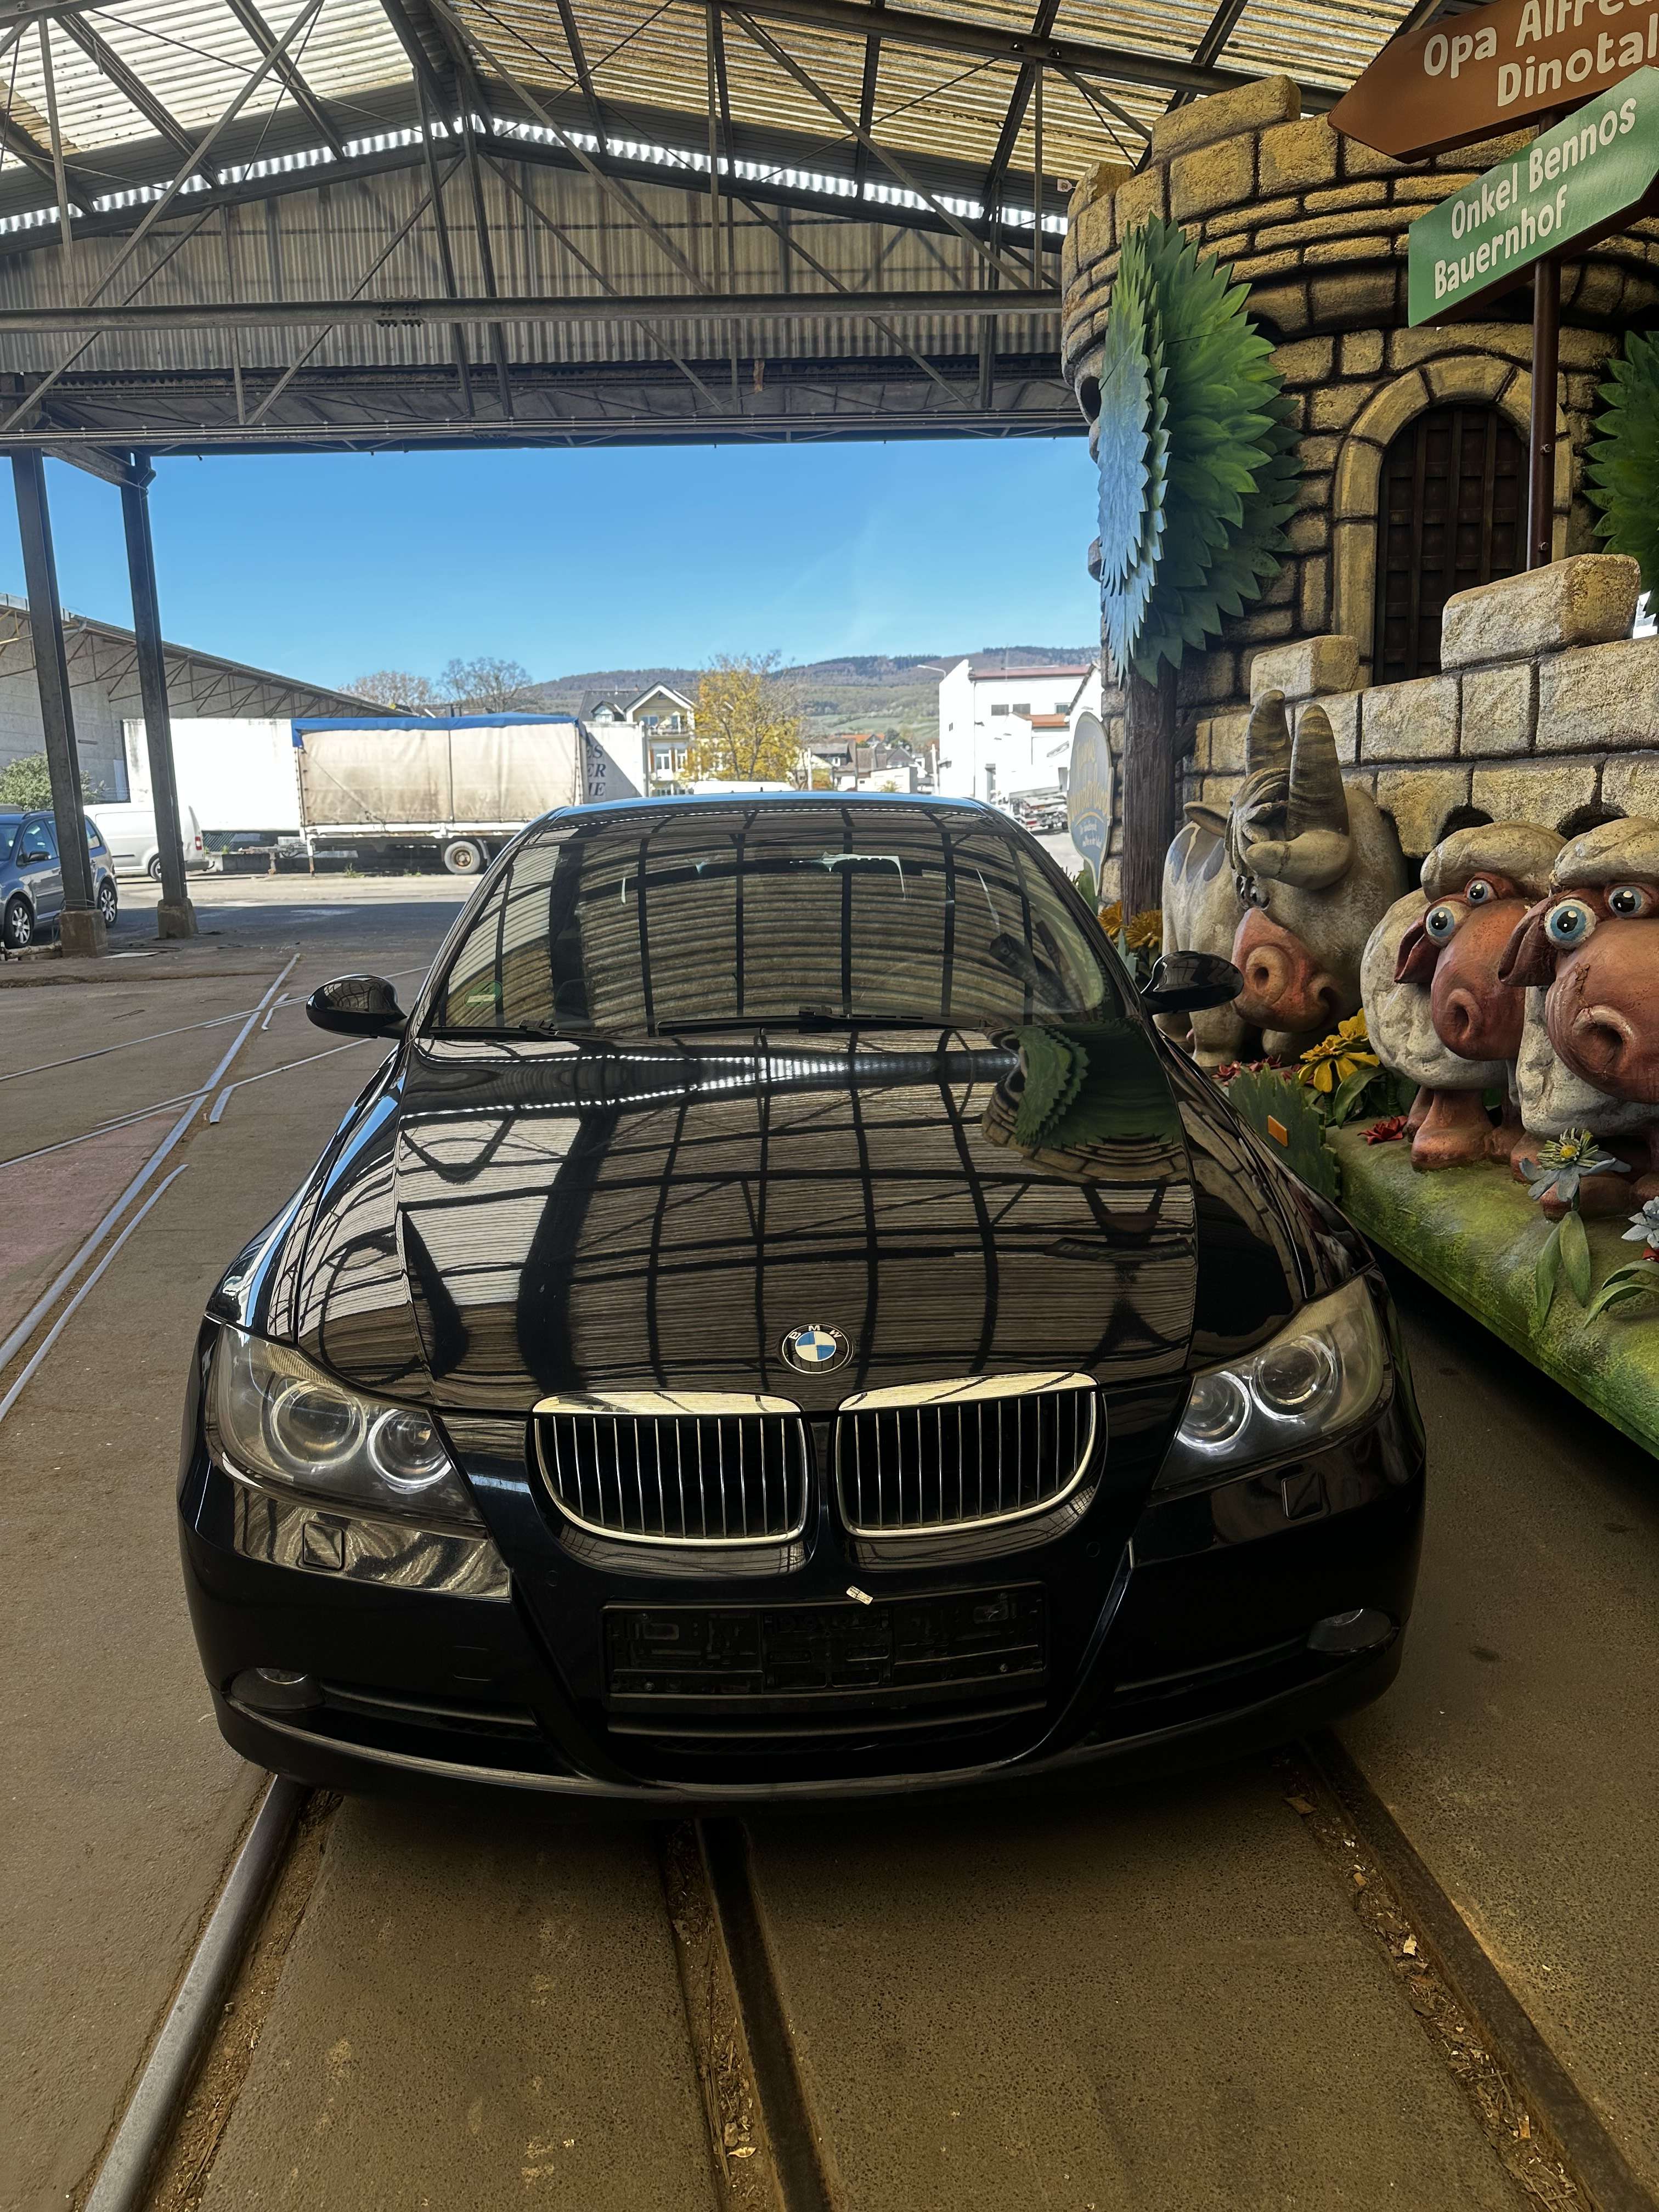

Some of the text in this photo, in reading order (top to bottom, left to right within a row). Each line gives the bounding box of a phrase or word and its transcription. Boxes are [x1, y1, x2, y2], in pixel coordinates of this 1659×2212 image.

[1424, 0, 1655, 78] Opa Alfre
[1498, 13, 1658, 106] Dinotal
[1451, 98, 1637, 239] Onkel Bennos
[1435, 184, 1567, 300] Bauernhof
[788, 1325, 842, 1340] BMW
